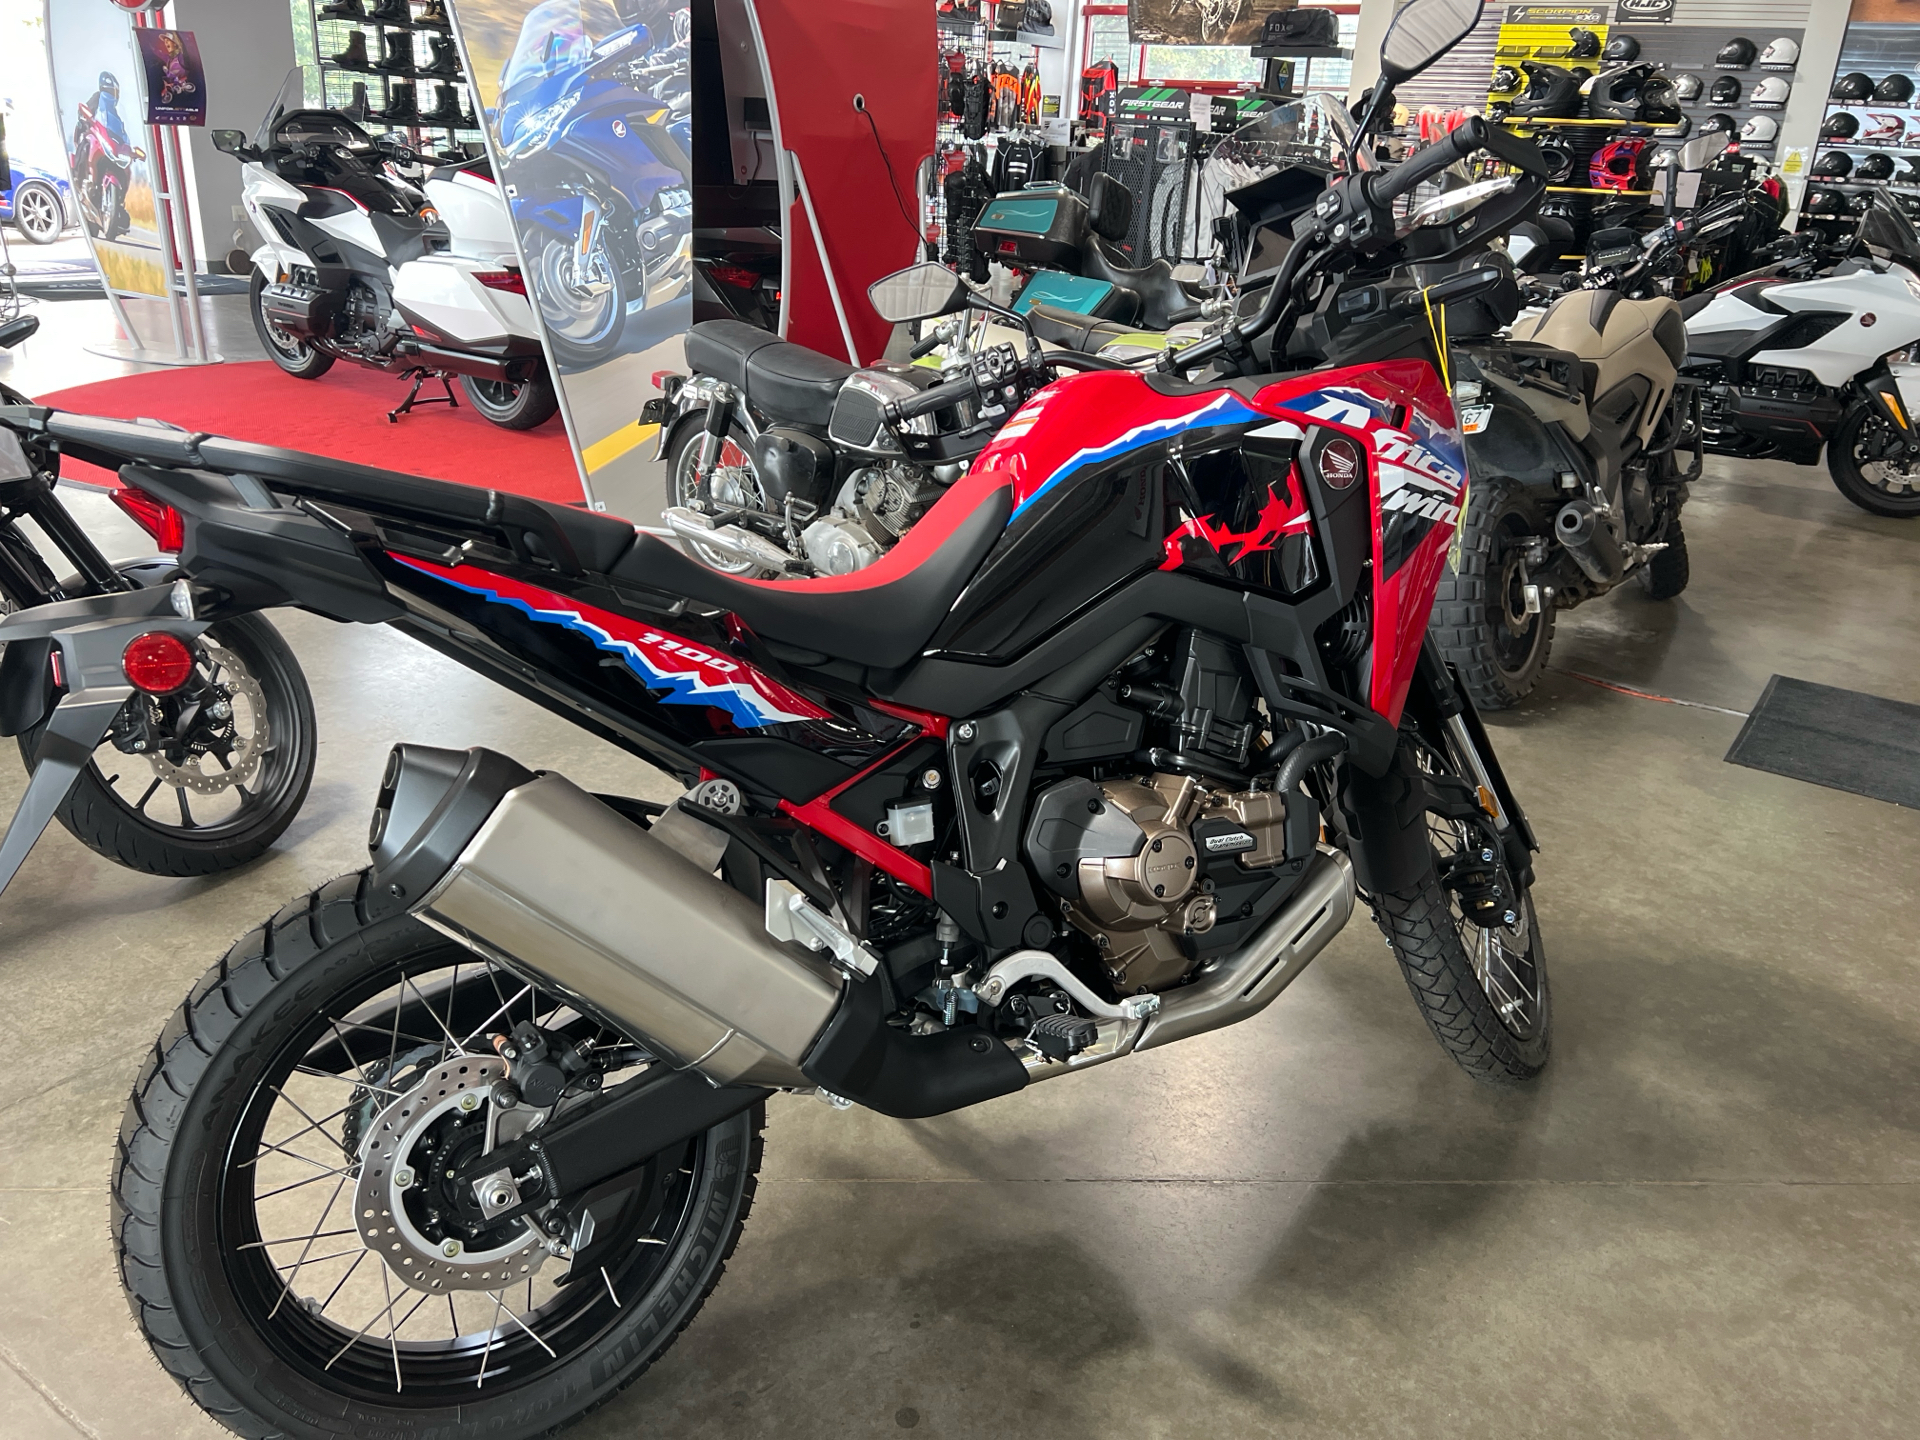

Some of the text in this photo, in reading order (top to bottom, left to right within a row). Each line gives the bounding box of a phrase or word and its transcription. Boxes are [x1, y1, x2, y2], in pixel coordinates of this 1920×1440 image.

[1630, 0, 1664, 8] HJC
[1526, 7, 1594, 15] SCORPION
[1269, 23, 1286, 32] FOX
[999, 76, 1017, 89] FOX
[1120, 98, 1185, 109] FIRSTGEAR
[638, 631, 740, 673] 1100
[1211, 840, 1251, 850] Transmission
[1148, 862, 1181, 873] HONDA
[322, 921, 423, 975] ADVENTU
[603, 1188, 730, 1378] MICHELIN
